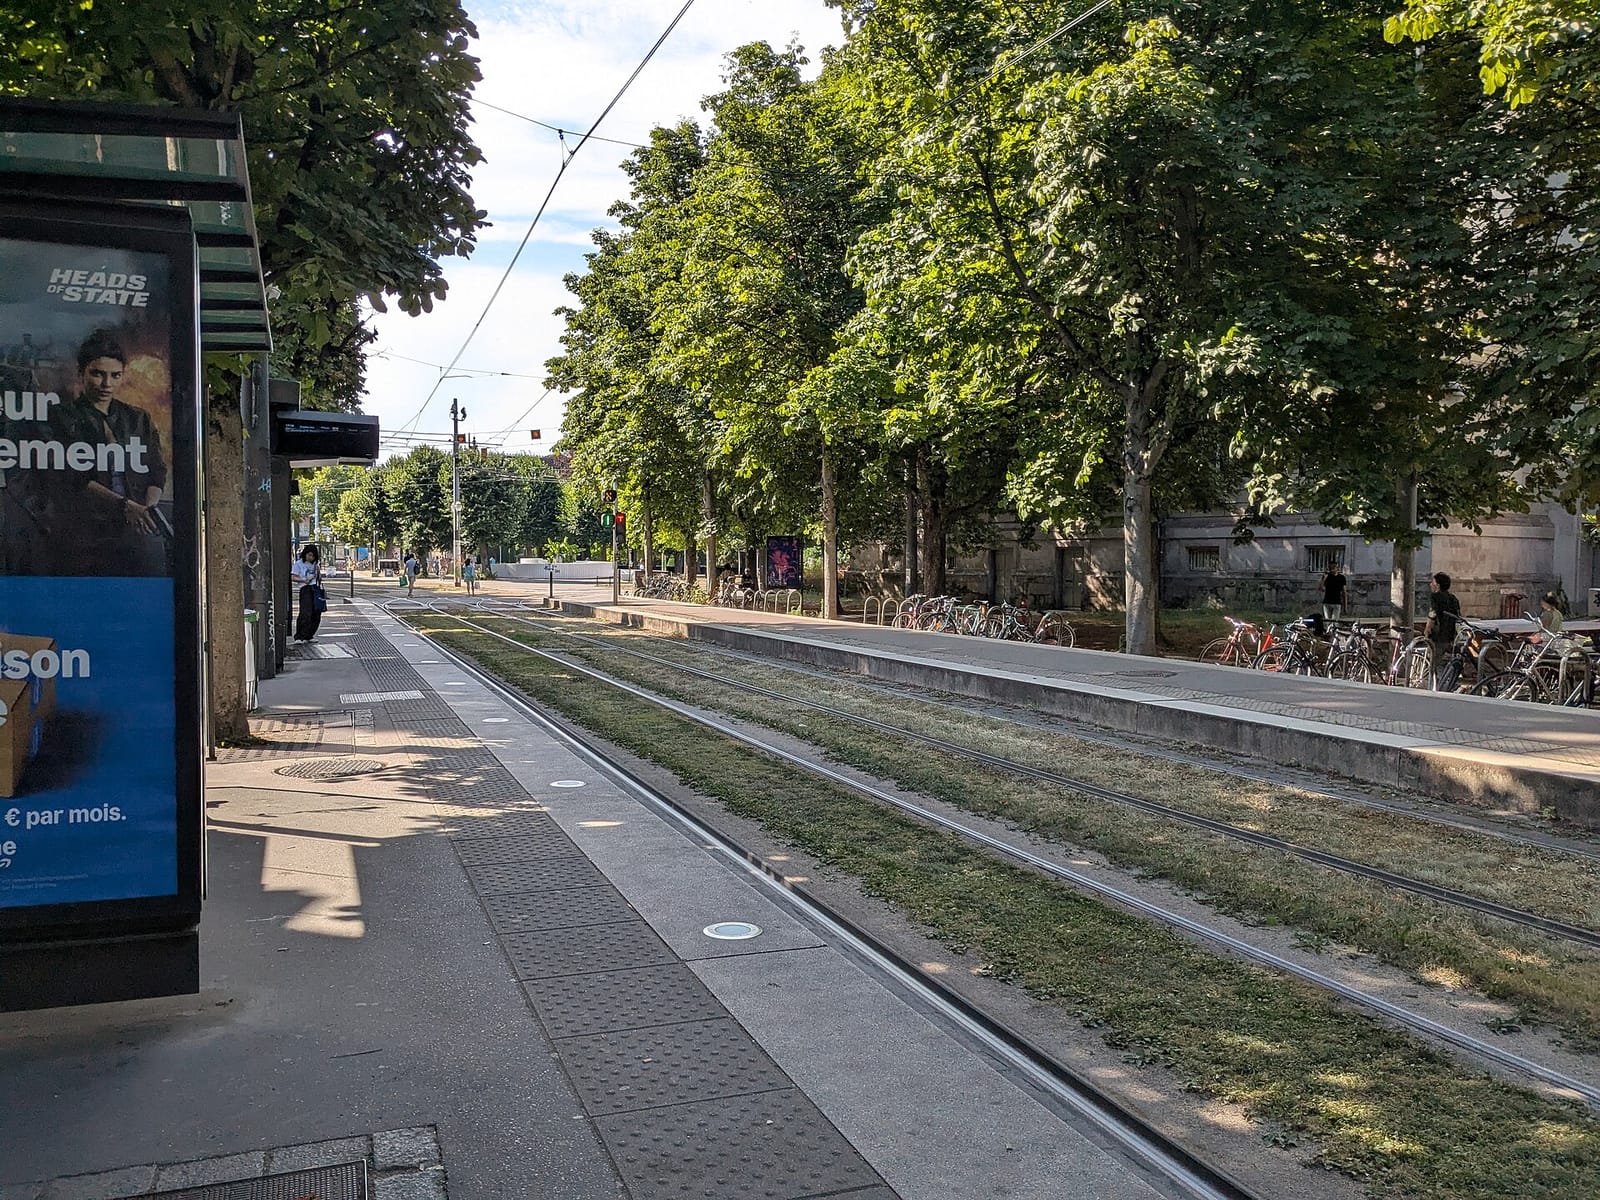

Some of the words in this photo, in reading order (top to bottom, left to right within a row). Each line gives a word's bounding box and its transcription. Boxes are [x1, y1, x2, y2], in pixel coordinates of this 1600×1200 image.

[49, 268, 147, 291] HEADS
[46, 285, 65, 294] OF
[62, 286, 150, 307] STATE
[0, 390, 61, 421] ur
[0, 649, 91, 679] son
[4, 807, 21, 827] €
[26, 809, 64, 830] par
[69, 803, 127, 823] mois.
